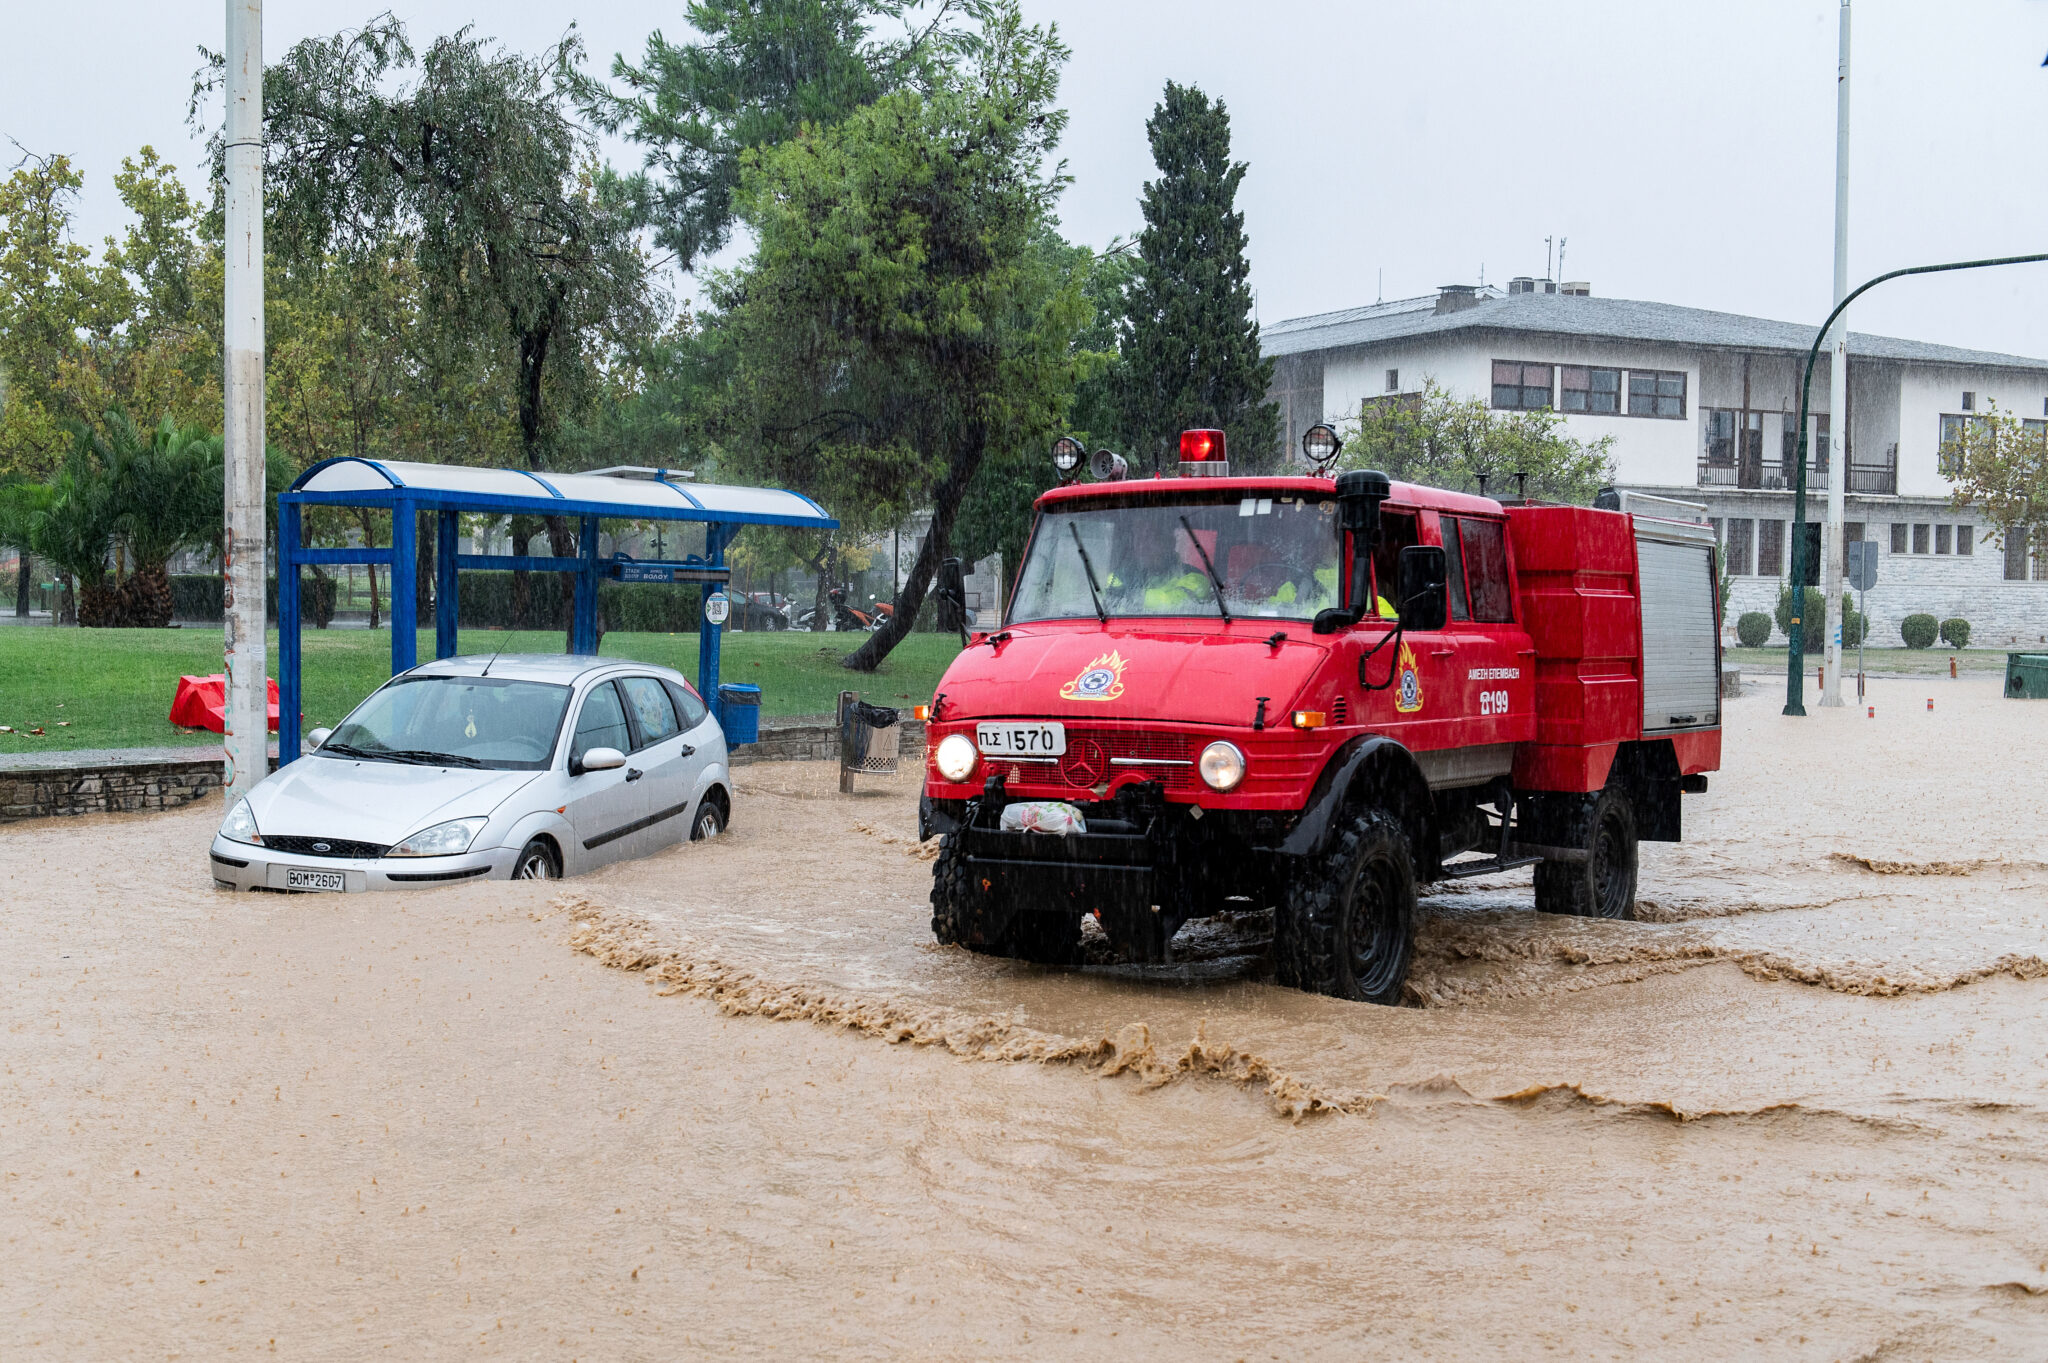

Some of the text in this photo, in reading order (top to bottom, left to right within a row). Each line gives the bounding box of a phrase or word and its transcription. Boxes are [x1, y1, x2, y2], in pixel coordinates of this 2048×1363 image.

[1468, 668, 1519, 680] ΑΜΕΣΗ ΕΠΕΜΒΑΣΗ
[1490, 690, 1508, 714] 199
[1007, 730, 1053, 750] 1570
